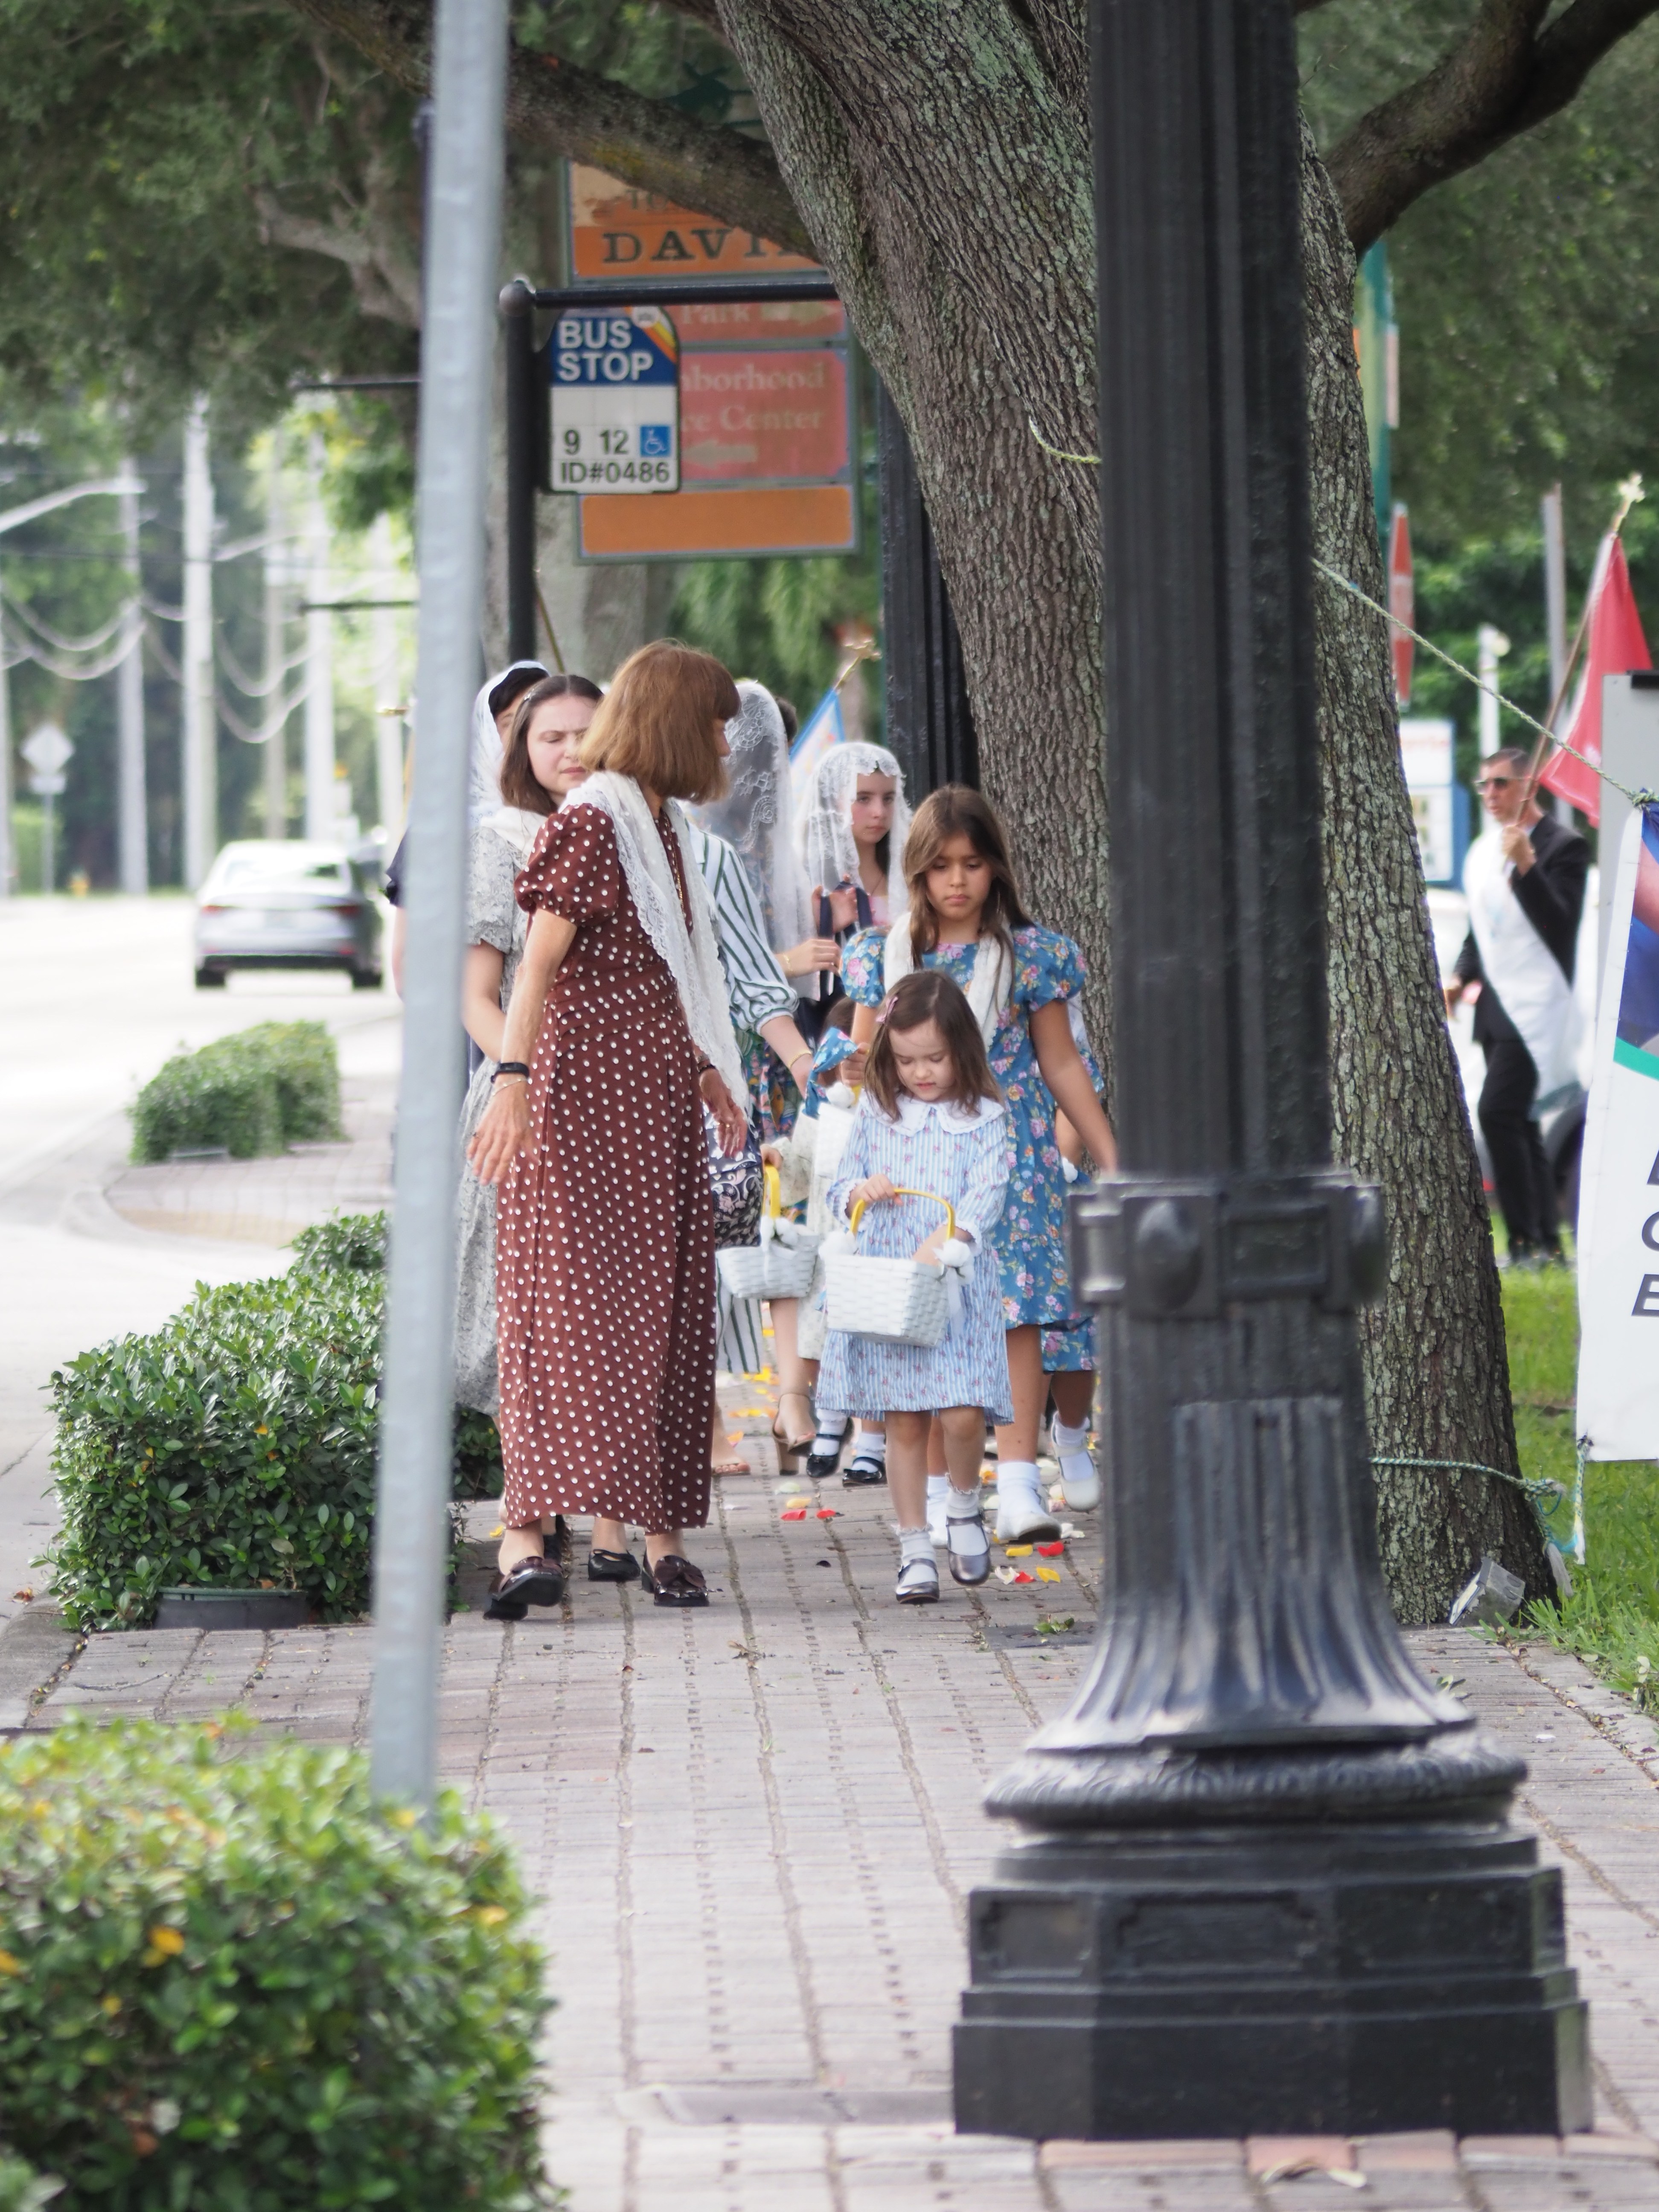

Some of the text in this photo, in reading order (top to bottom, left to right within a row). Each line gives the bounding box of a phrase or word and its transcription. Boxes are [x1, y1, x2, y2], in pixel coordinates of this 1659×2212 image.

[603, 227, 789, 263] DAVI
[559, 320, 632, 349] BUS
[558, 351, 653, 381] STOP
[720, 405, 822, 430] Center
[563, 429, 629, 455] 9 12
[561, 461, 669, 483] ID#0486
